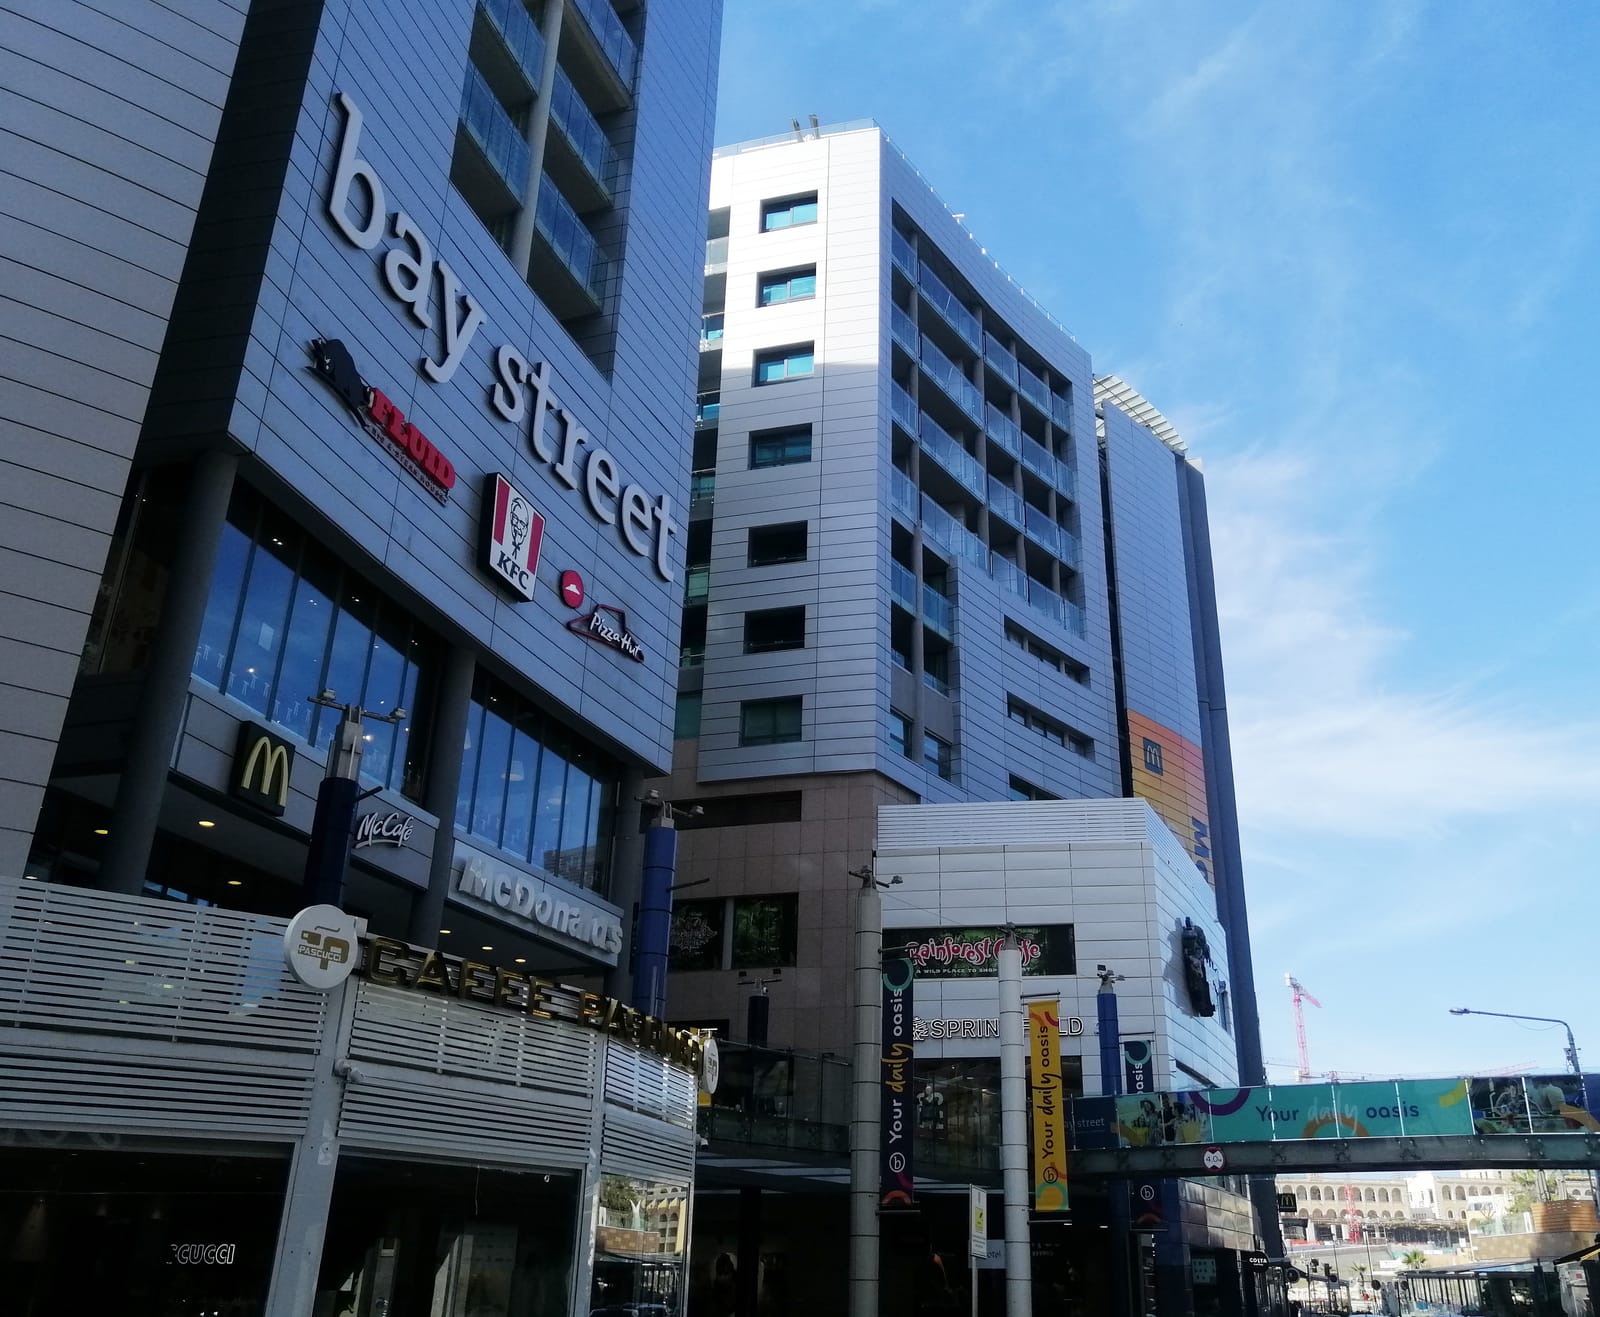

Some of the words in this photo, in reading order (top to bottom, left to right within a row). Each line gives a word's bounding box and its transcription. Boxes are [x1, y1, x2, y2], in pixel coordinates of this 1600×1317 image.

[327, 91, 487, 383] bay
[492, 343, 678, 582] street
[369, 387, 456, 489] FLUID
[496, 551, 529, 590] KFC
[589, 612, 621, 642] Pizza
[620, 632, 641, 656] Hut
[357, 812, 414, 847] McCafé
[298, 944, 342, 962] PASCUCCI
[905, 937, 992, 966] Rainforest
[993, 938, 1041, 966] Cfe
[890, 988, 903, 1038] oasis
[1038, 1025, 1050, 1067] oasis
[882, 1043, 914, 1093] daily
[1132, 1062, 1144, 1094] asis
[1032, 1073, 1063, 1115] daily
[1256, 1105, 1299, 1122] Your
[1307, 1089, 1359, 1135] daily
[1366, 1101, 1420, 1119] oasis
[889, 1099, 903, 1144] Your
[1042, 1121, 1054, 1159] Your
